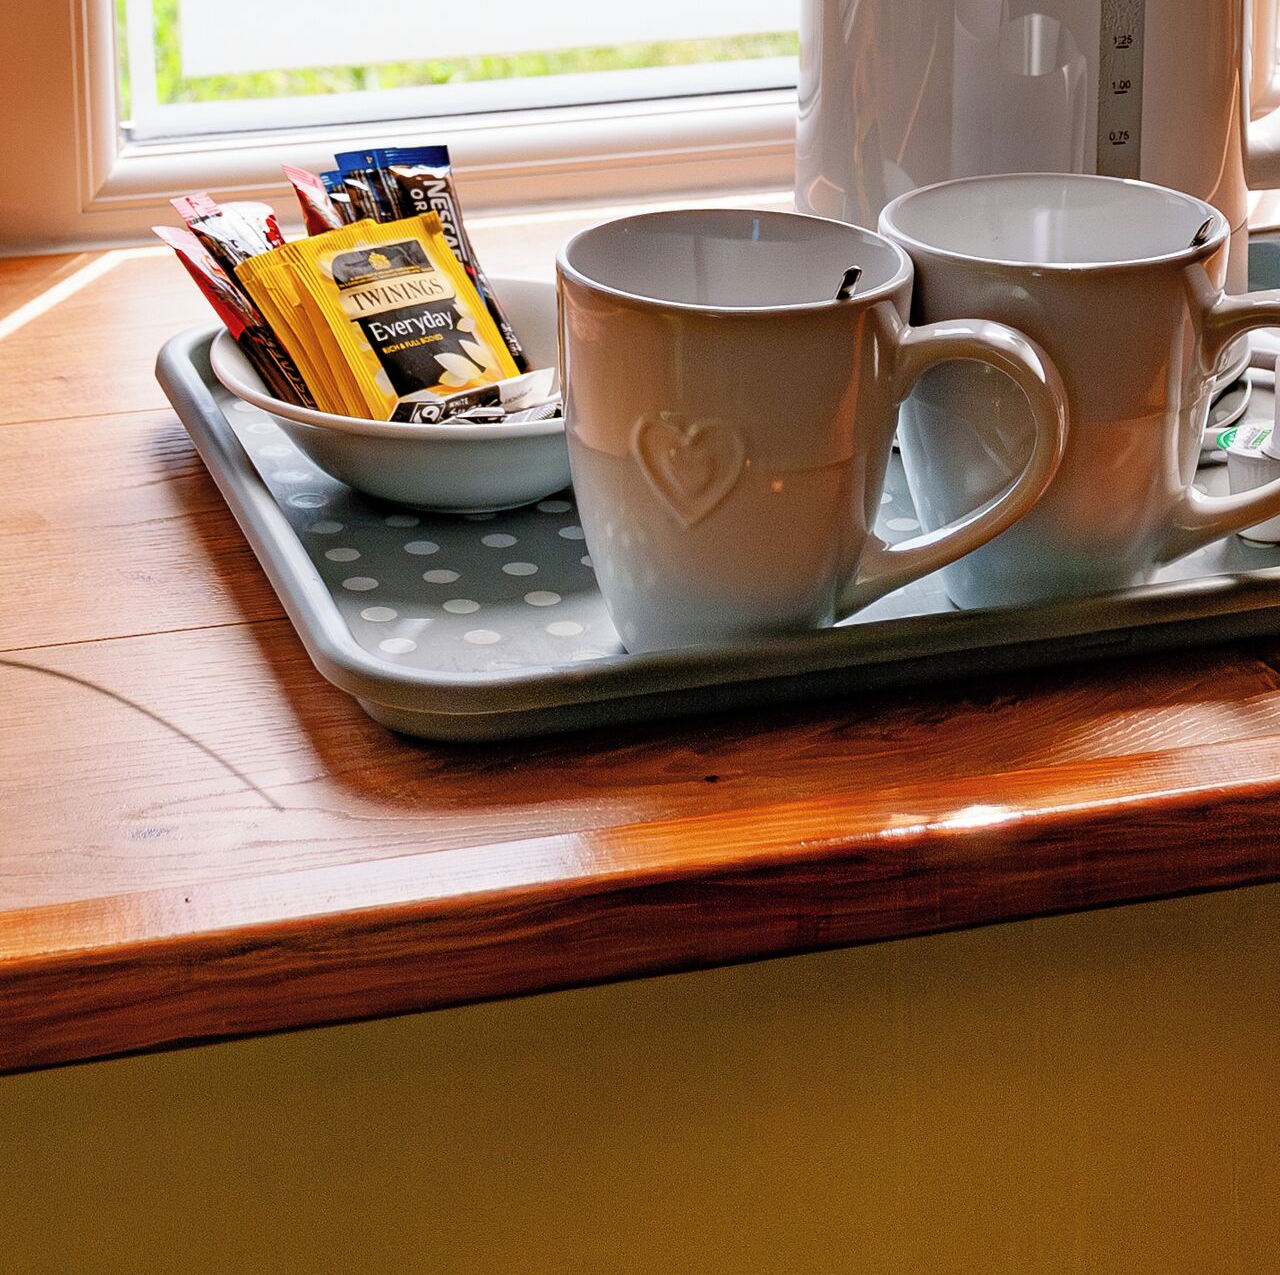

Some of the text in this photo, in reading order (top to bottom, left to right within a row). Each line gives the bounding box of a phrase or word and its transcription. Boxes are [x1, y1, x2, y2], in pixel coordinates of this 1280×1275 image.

[423, 179, 470, 269] NESCAF
[349, 278, 445, 311] TWININGS
[368, 310, 453, 342] Everyday
